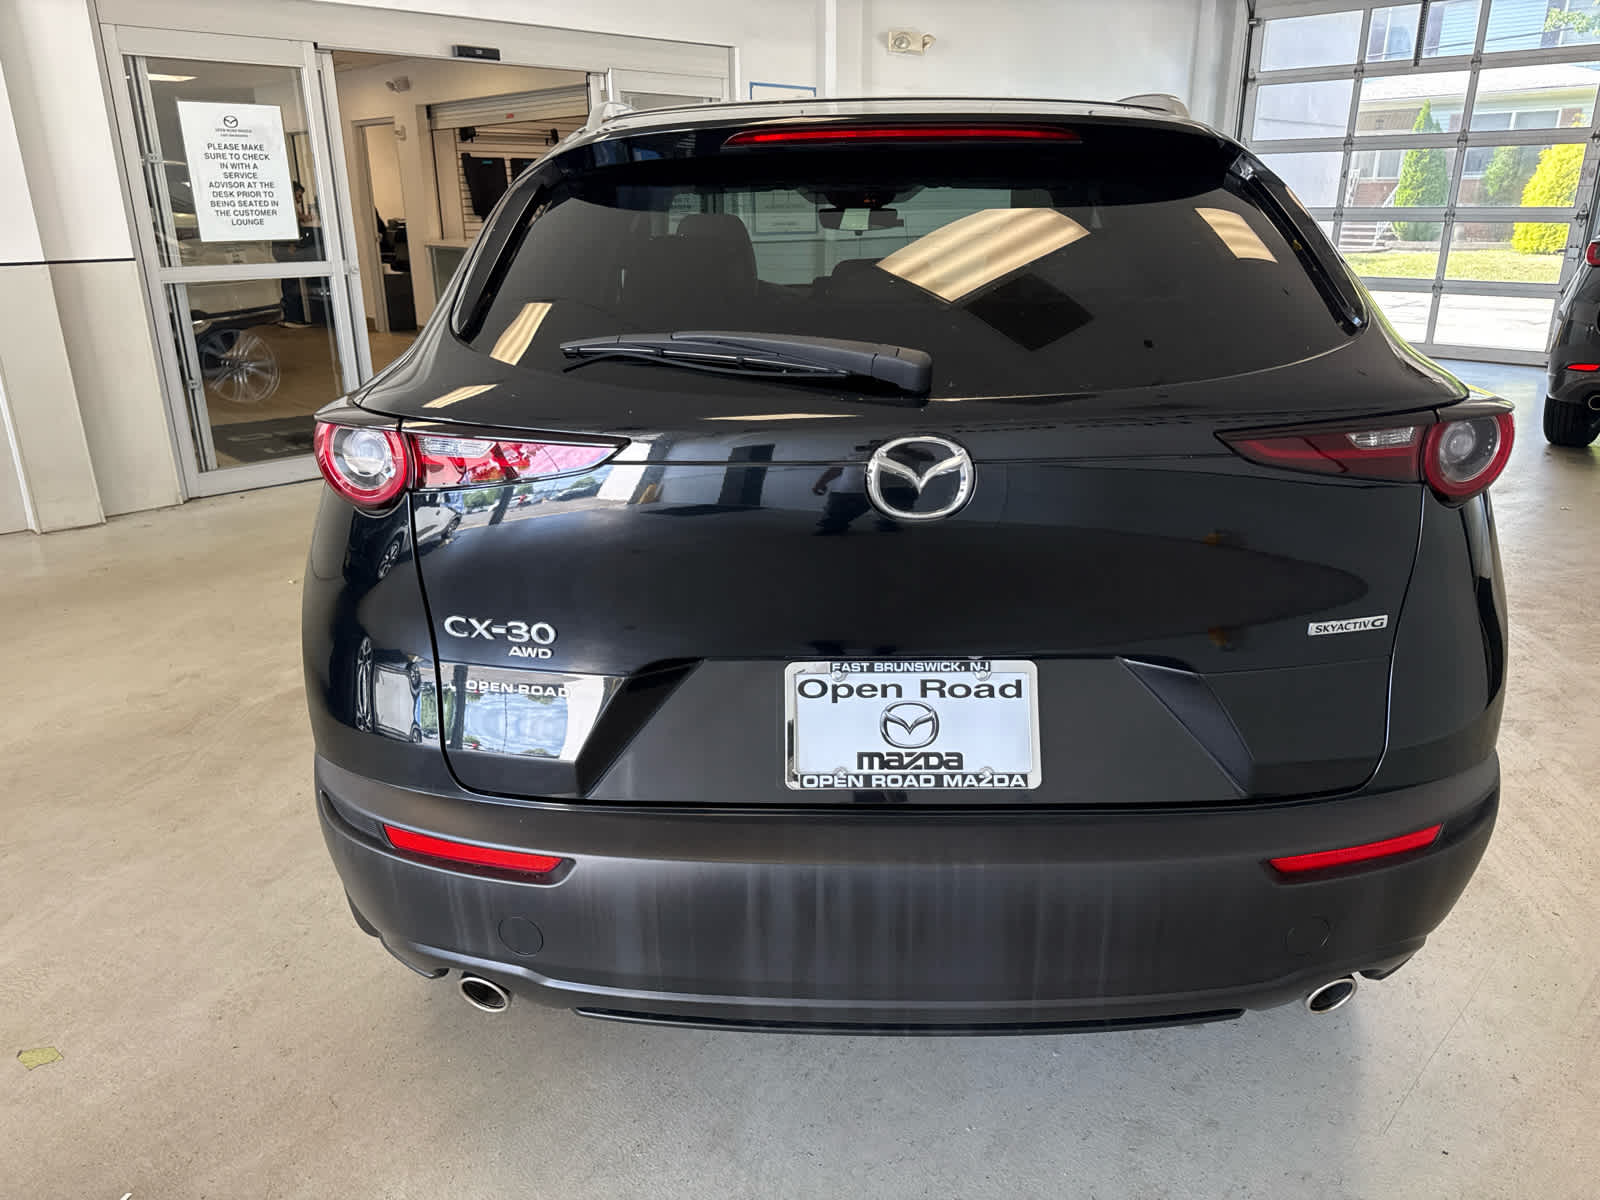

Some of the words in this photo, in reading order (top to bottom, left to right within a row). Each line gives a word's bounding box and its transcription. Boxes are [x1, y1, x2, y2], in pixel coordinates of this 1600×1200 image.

[207, 143, 240, 151] PLEASE
[241, 144, 265, 152] MAKE
[204, 152, 227, 160] SURE
[228, 153, 241, 161] TO
[242, 153, 271, 161] CHECK
[220, 162, 229, 170] IN
[230, 162, 250, 170] WITH
[223, 172, 258, 180] SERVICE
[208, 181, 246, 189] ADVISOR
[247, 181, 258, 189] AT
[259, 181, 275, 189] THE
[212, 190, 235, 198] DESK
[236, 190, 262, 198] PRIOR
[263, 190, 275, 198] TO
[210, 200, 237, 208] BEING
[237, 200, 270, 208] SEATED
[270, 200, 279, 208] IN
[215, 209, 232, 217] THE
[232, 209, 278, 217] CUSTOMER
[231, 218, 265, 226] LOUNGE
[443, 615, 557, 645] CX-30
[508, 645, 552, 659] AWD
[873, 661, 967, 673] BRUNSWICK,
[465, 679, 514, 694] OPEN
[518, 684, 570, 698] ROAD
[797, 678, 904, 704] Open
[919, 678, 1023, 699] Road
[802, 774, 864, 788] OPEN
[871, 774, 936, 788] ROAD
[942, 774, 1027, 788] MAZDA
